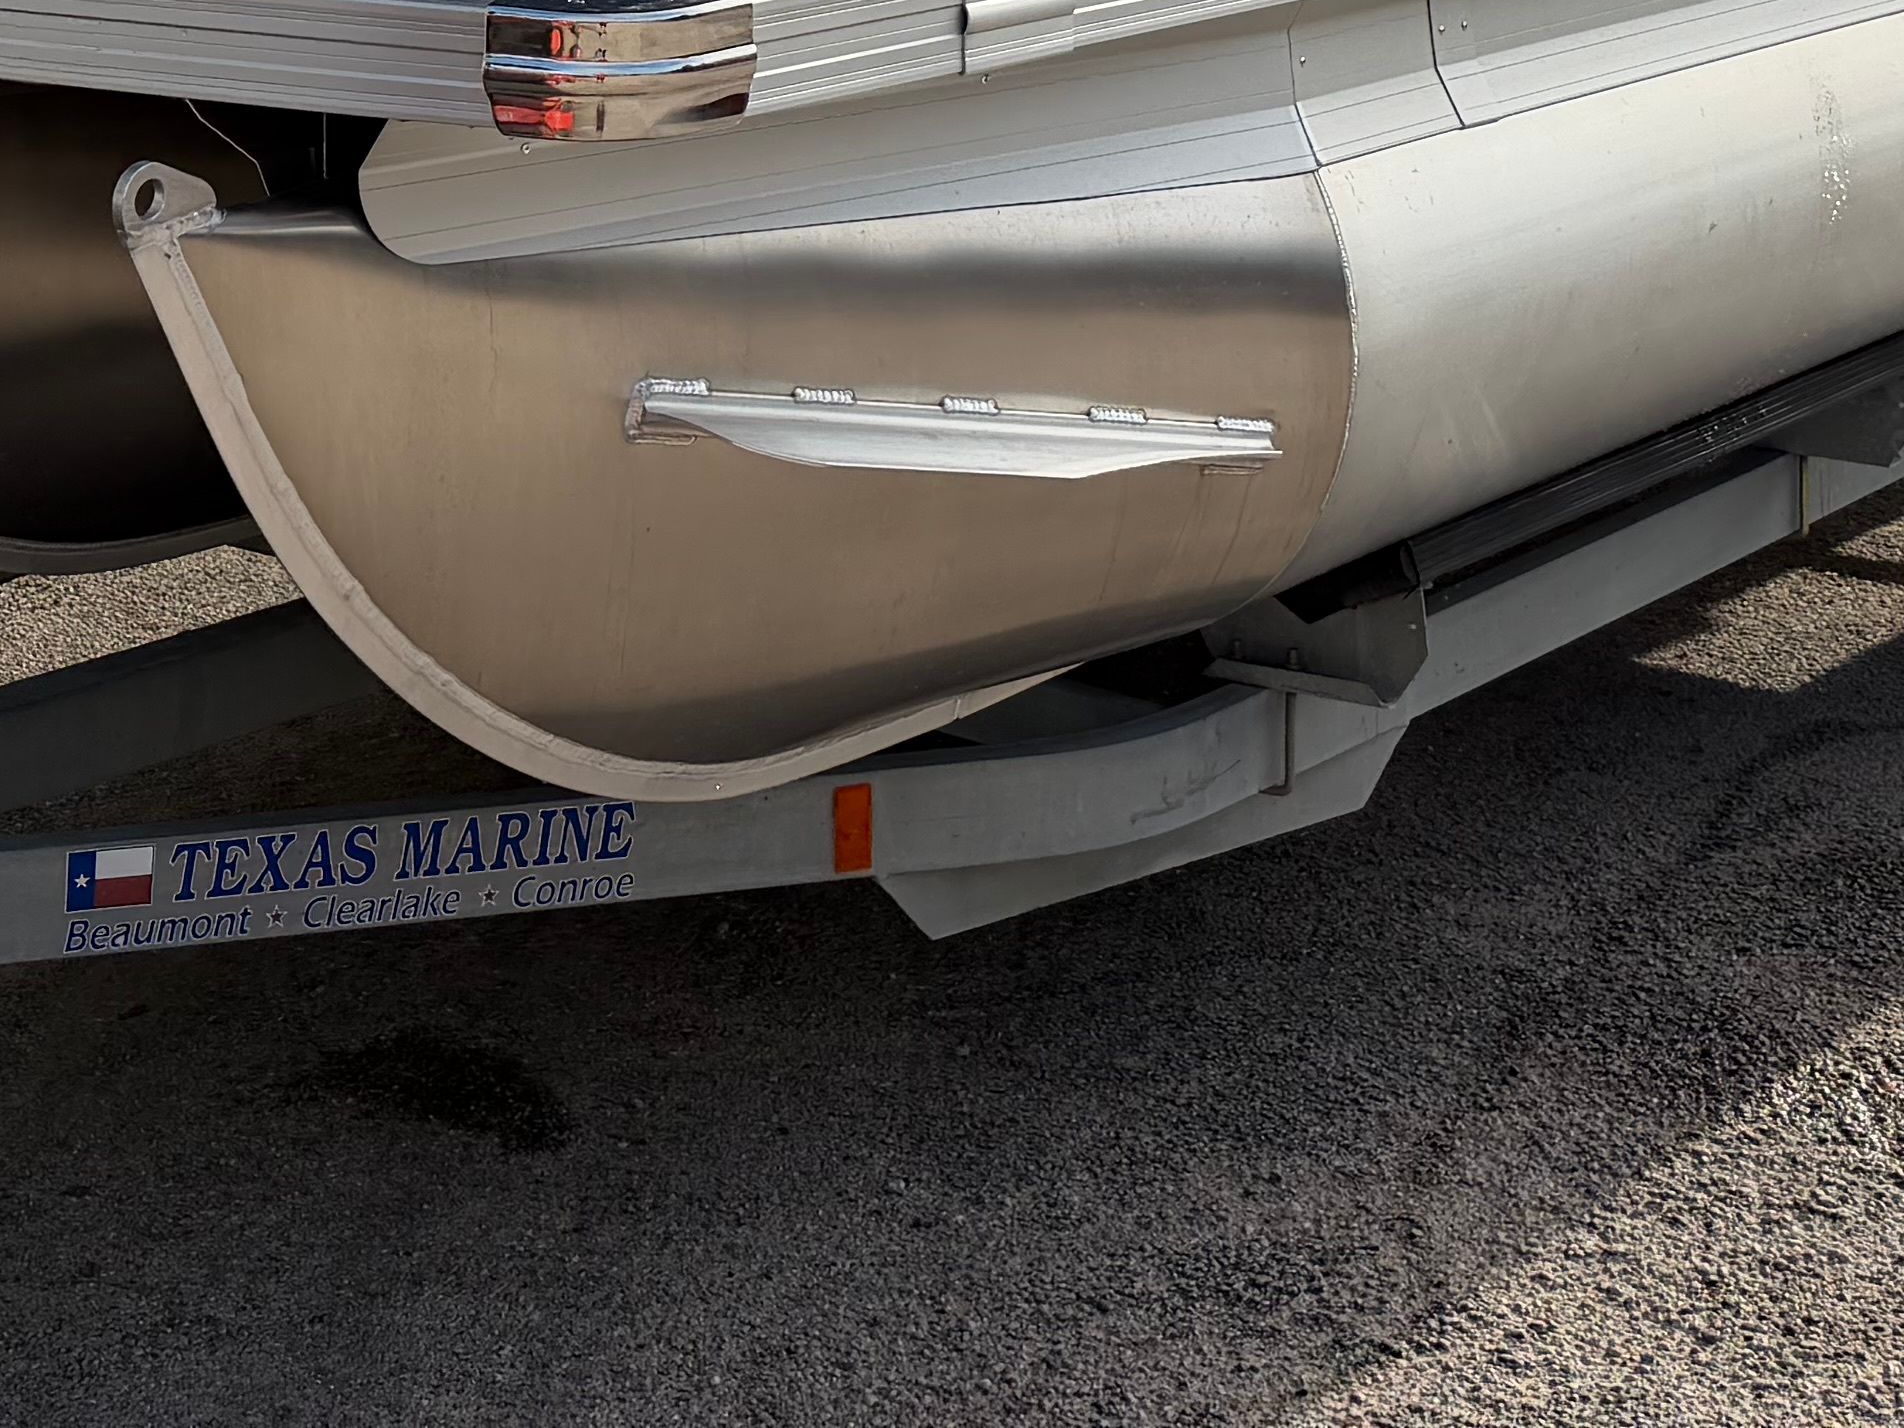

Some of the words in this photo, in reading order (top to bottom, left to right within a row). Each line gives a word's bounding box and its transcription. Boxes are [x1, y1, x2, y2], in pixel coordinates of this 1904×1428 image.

[169, 824, 378, 903] TEXAS
[394, 800, 635, 882] MARINE
[64, 905, 252, 953] Beaumont
[303, 885, 461, 929] Clearlake
[512, 872, 635, 909] Conroe
